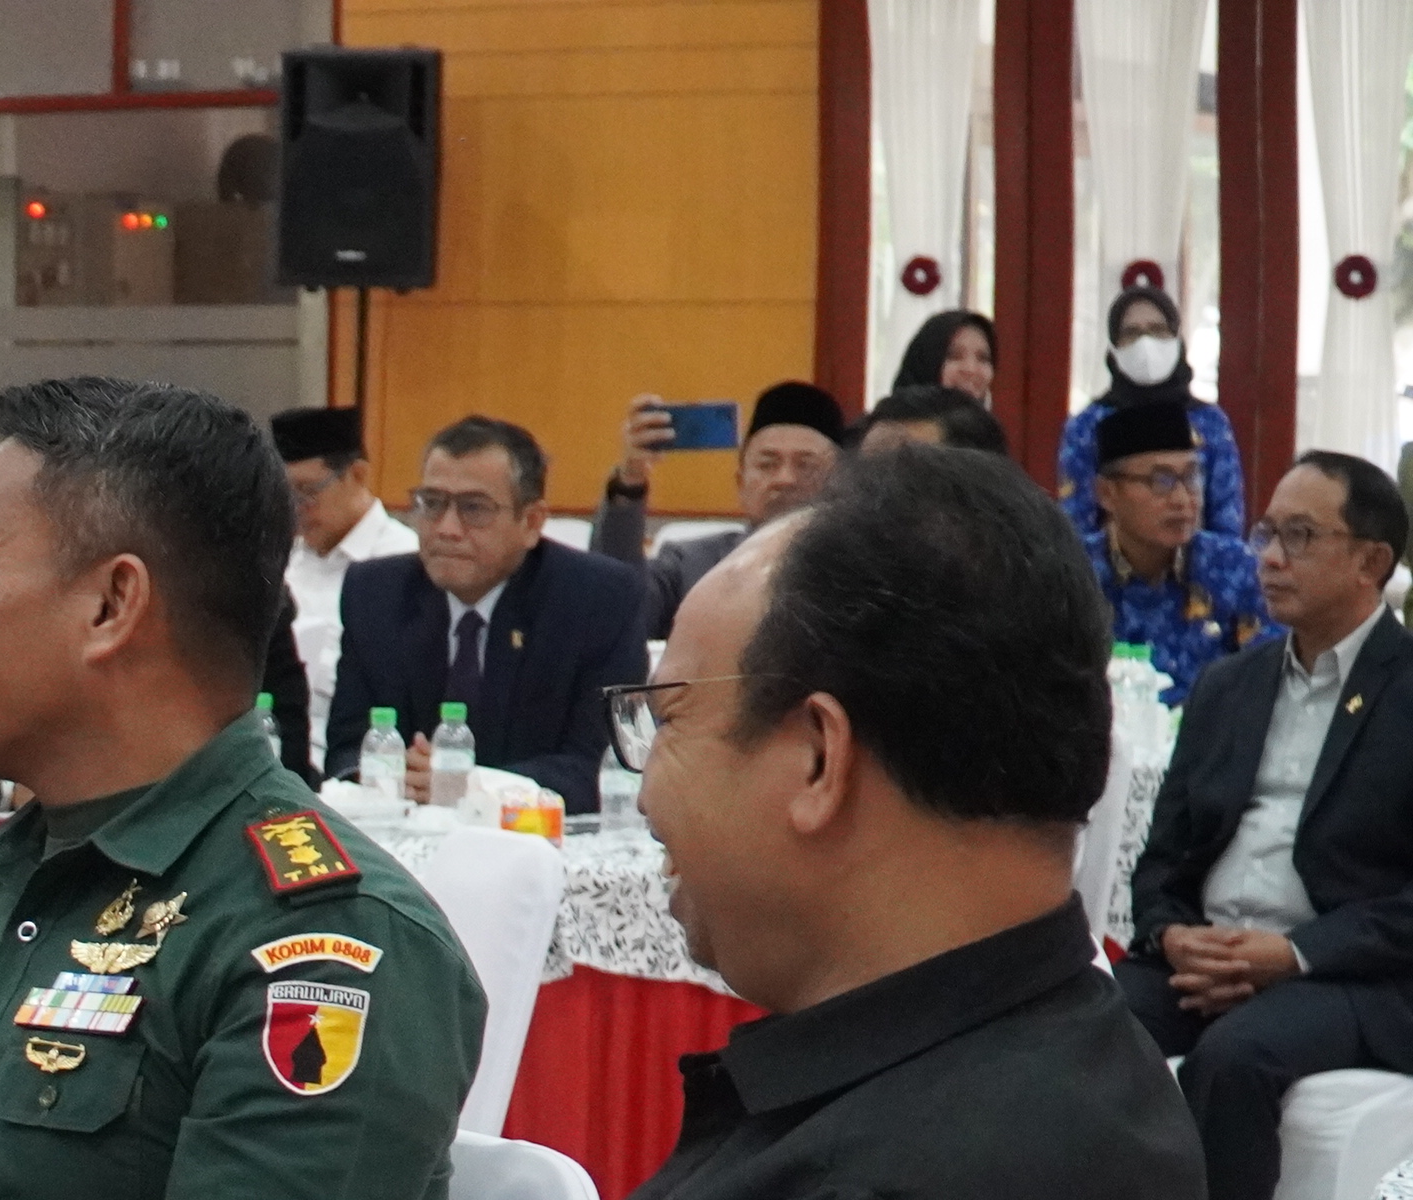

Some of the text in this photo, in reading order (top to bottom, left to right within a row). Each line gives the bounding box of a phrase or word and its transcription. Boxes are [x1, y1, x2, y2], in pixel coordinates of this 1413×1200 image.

[284, 861, 346, 882] TNI
[265, 938, 325, 964] KODIM
[274, 985, 365, 1009] BRAWIJAYA
